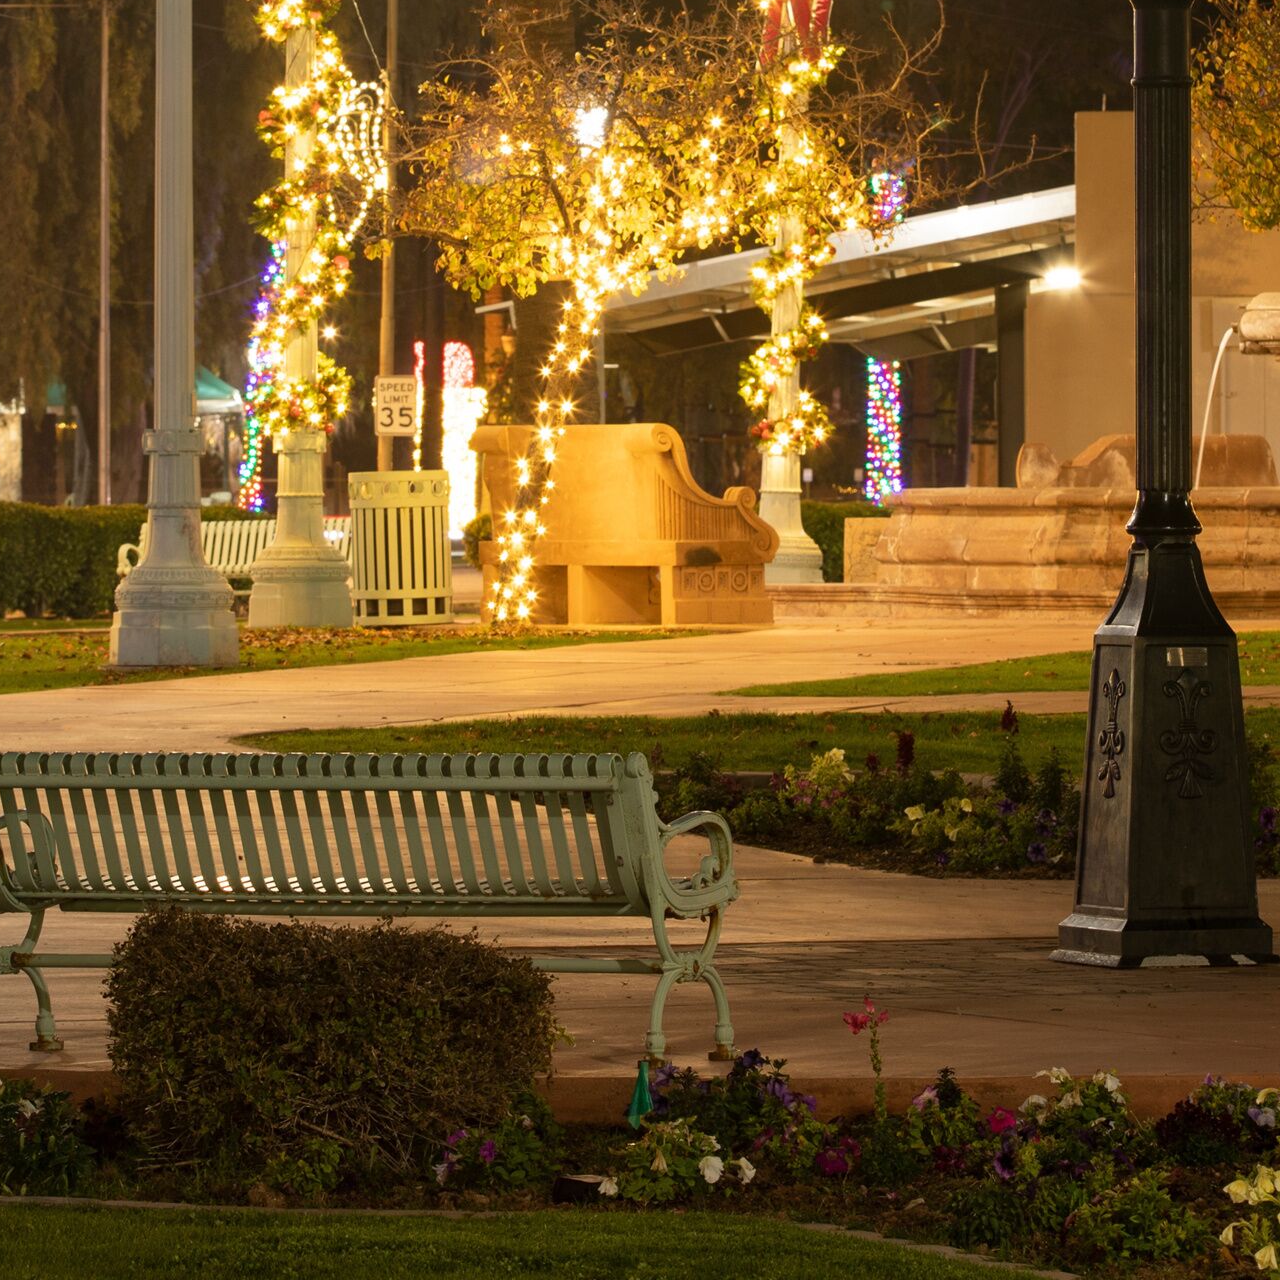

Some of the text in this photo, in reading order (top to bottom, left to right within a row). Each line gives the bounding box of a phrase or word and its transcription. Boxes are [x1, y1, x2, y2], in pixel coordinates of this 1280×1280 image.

[380, 382, 414, 392] SPEED
[383, 395, 409, 404] LIMIT
[380, 407, 413, 427] 35
